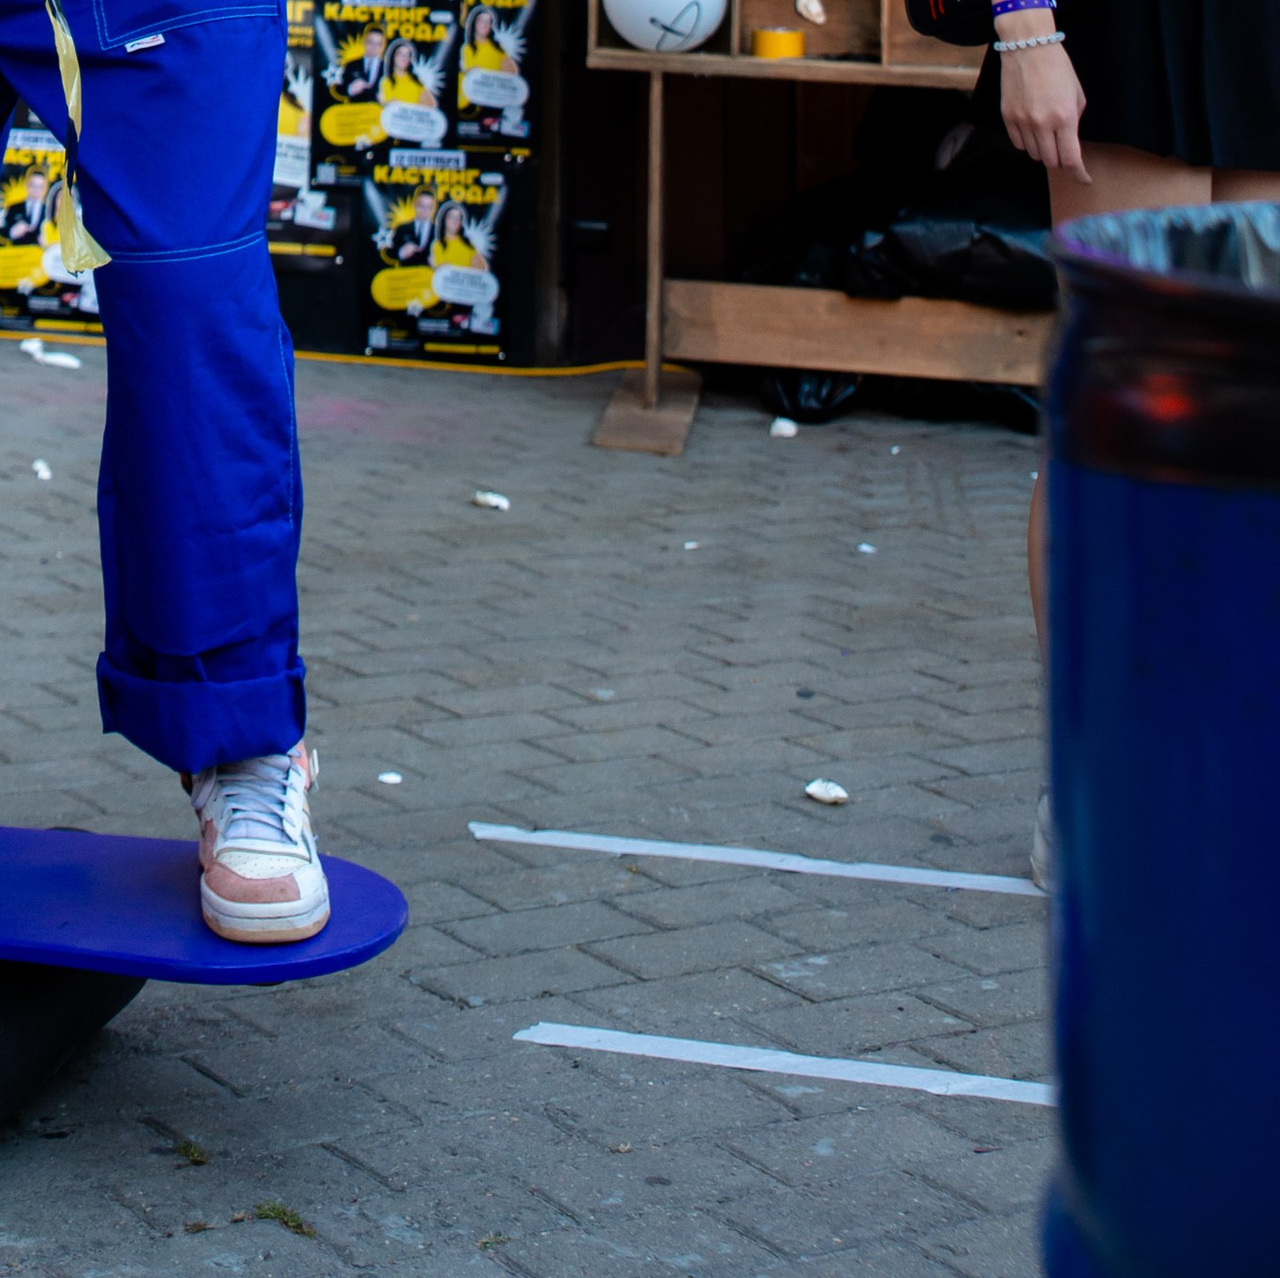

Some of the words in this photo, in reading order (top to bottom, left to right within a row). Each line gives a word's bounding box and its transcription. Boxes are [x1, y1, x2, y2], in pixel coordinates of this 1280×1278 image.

[324, 2, 430, 22] КАСТИНГ
[386, 22, 448, 42] ГОДА
[374, 164, 480, 184] КАСТИНГ
[437, 183, 499, 203] ГОДА
